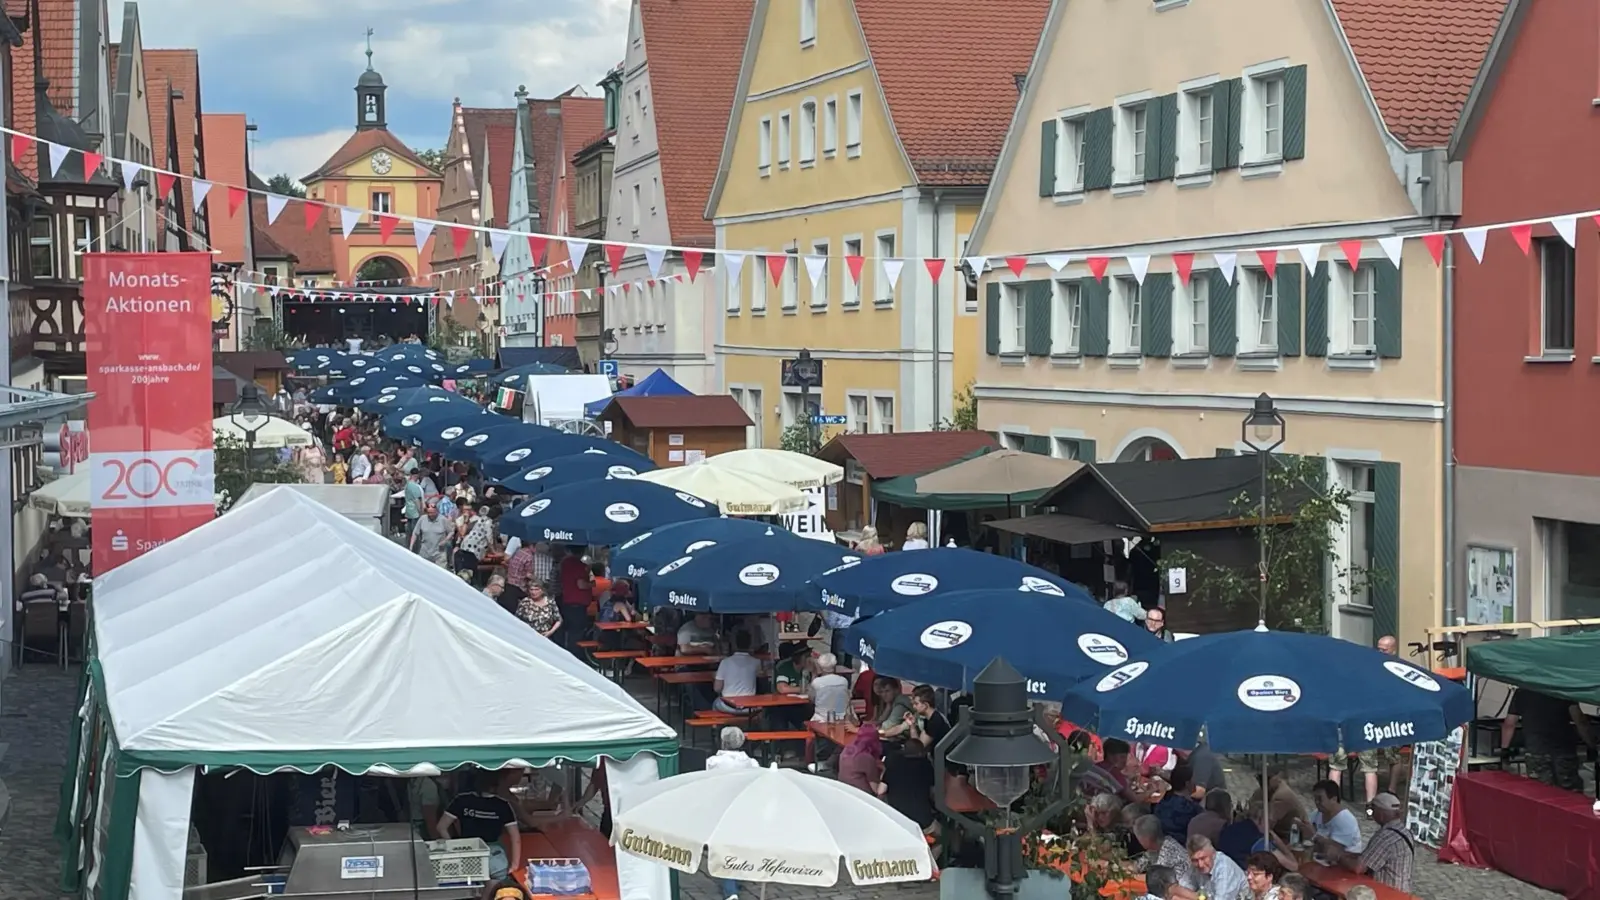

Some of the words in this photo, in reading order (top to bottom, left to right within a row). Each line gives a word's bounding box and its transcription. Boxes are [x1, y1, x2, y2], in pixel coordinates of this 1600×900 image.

[109, 271, 187, 288] Monats-
[105, 296, 191, 313] Aktionen
[99, 362, 201, 374] sparkasse-ansbach.de/
[603, 363, 613, 375] P
[131, 374, 169, 386] 200jahre
[726, 501, 772, 513] Gutmann
[1174, 577, 1181, 588] 9
[1123, 716, 1176, 740] Spalter
[1363, 720, 1415, 744] Spalter
[622, 828, 693, 867] Gutmann
[722, 855, 755, 871] Gutes
[757, 858, 825, 878] Hefeweizen
[853, 858, 920, 880] Gutmann
